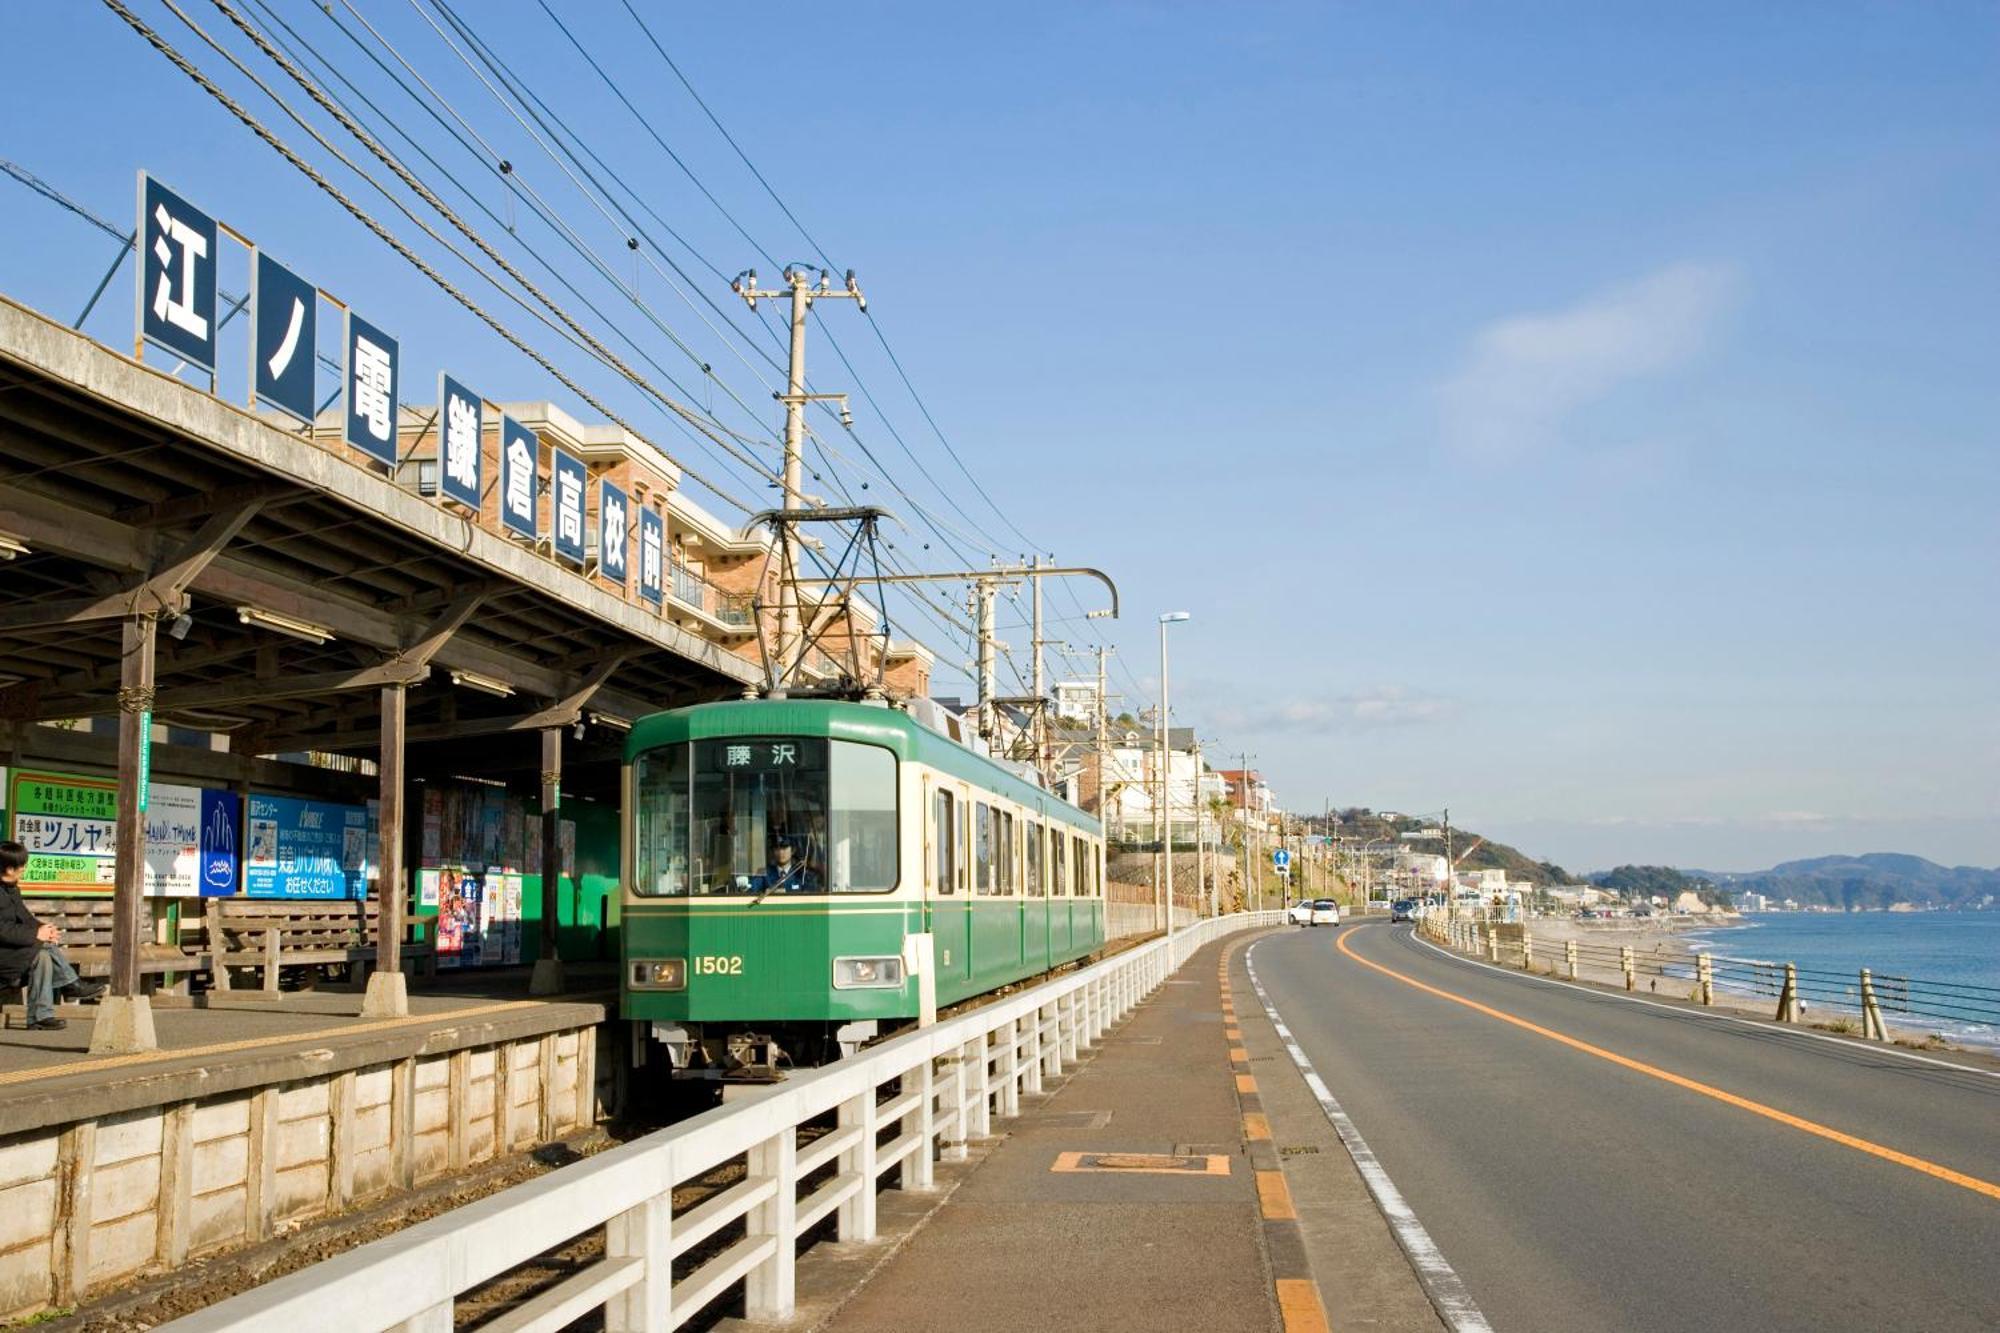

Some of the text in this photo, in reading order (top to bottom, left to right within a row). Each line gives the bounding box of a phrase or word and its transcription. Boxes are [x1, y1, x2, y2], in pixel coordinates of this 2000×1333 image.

[154, 202, 661, 590] 江ノ電 鎌倉高校前
[726, 745, 796, 766] 藤沢
[44, 821, 102, 851] ツルヤ
[286, 877, 335, 894] お任せください
[695, 956, 742, 975] 1502
